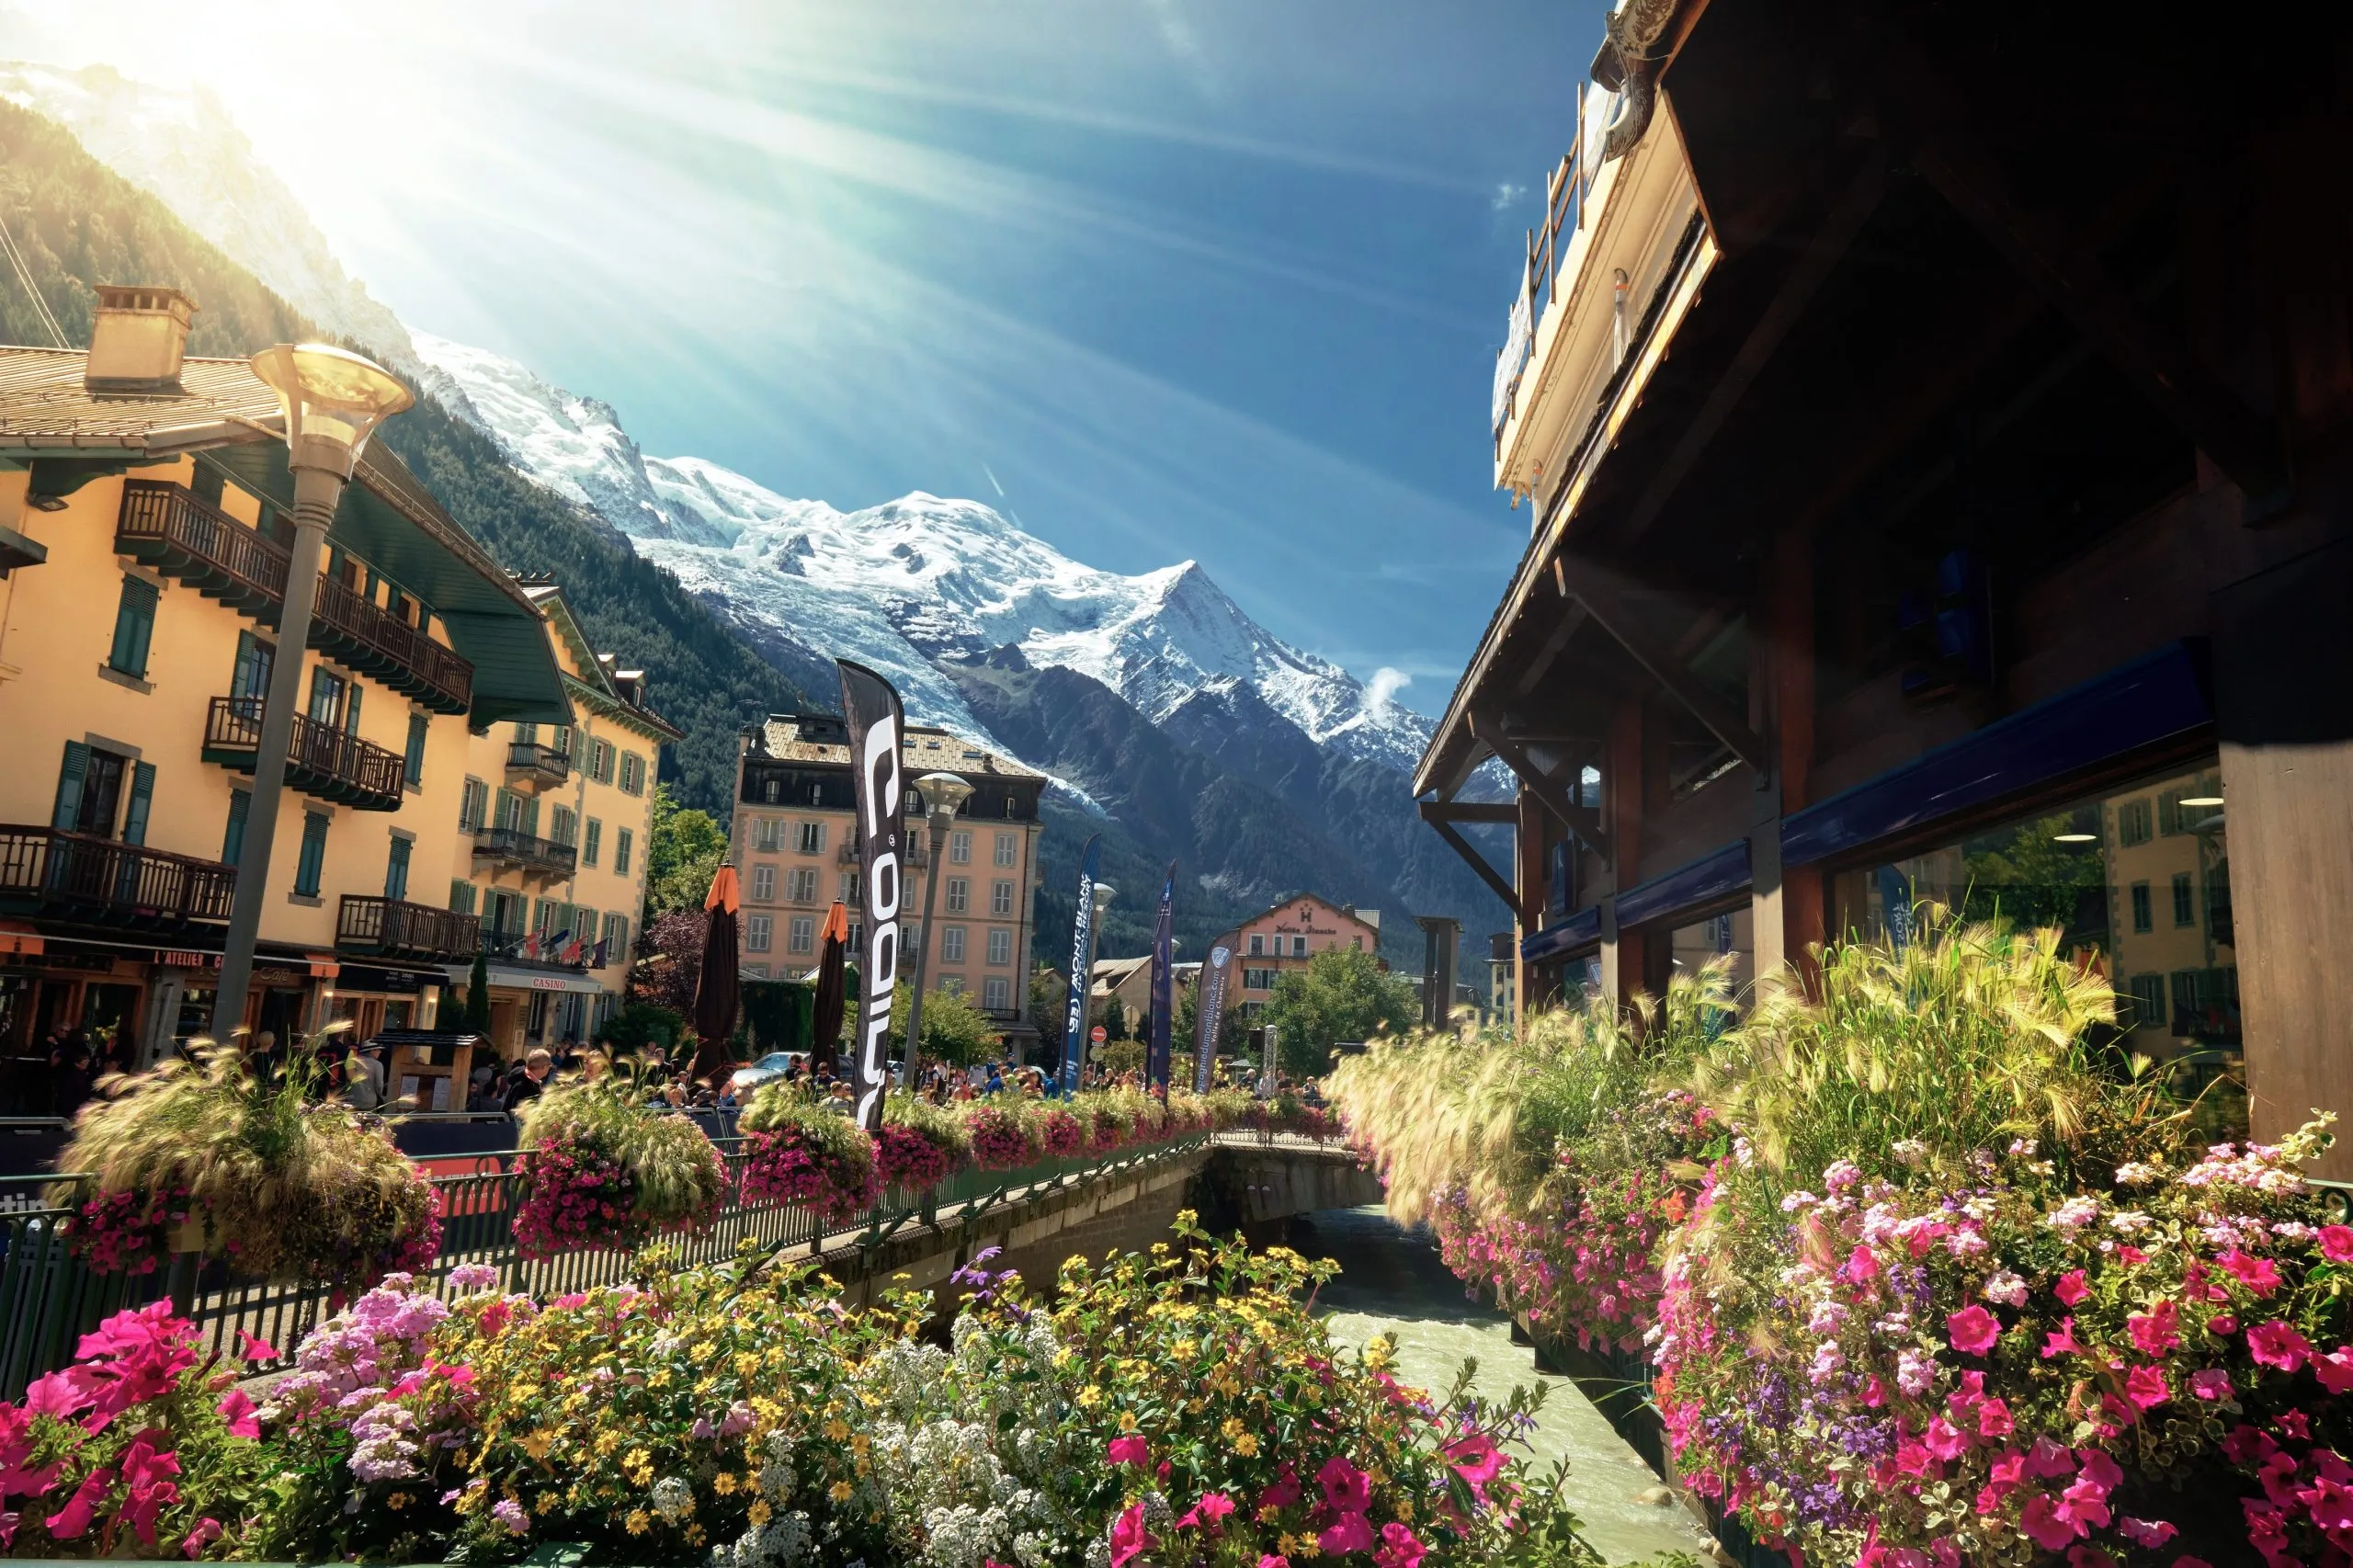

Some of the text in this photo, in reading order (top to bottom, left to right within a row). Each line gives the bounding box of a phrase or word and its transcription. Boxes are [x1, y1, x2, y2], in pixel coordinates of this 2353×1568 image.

[1071, 871, 1092, 988] MONT-BLANC
[154, 950, 203, 967] L'ATELIER
[532, 978, 566, 990] CASINO
[1216, 976, 1225, 1008] Chamonix
